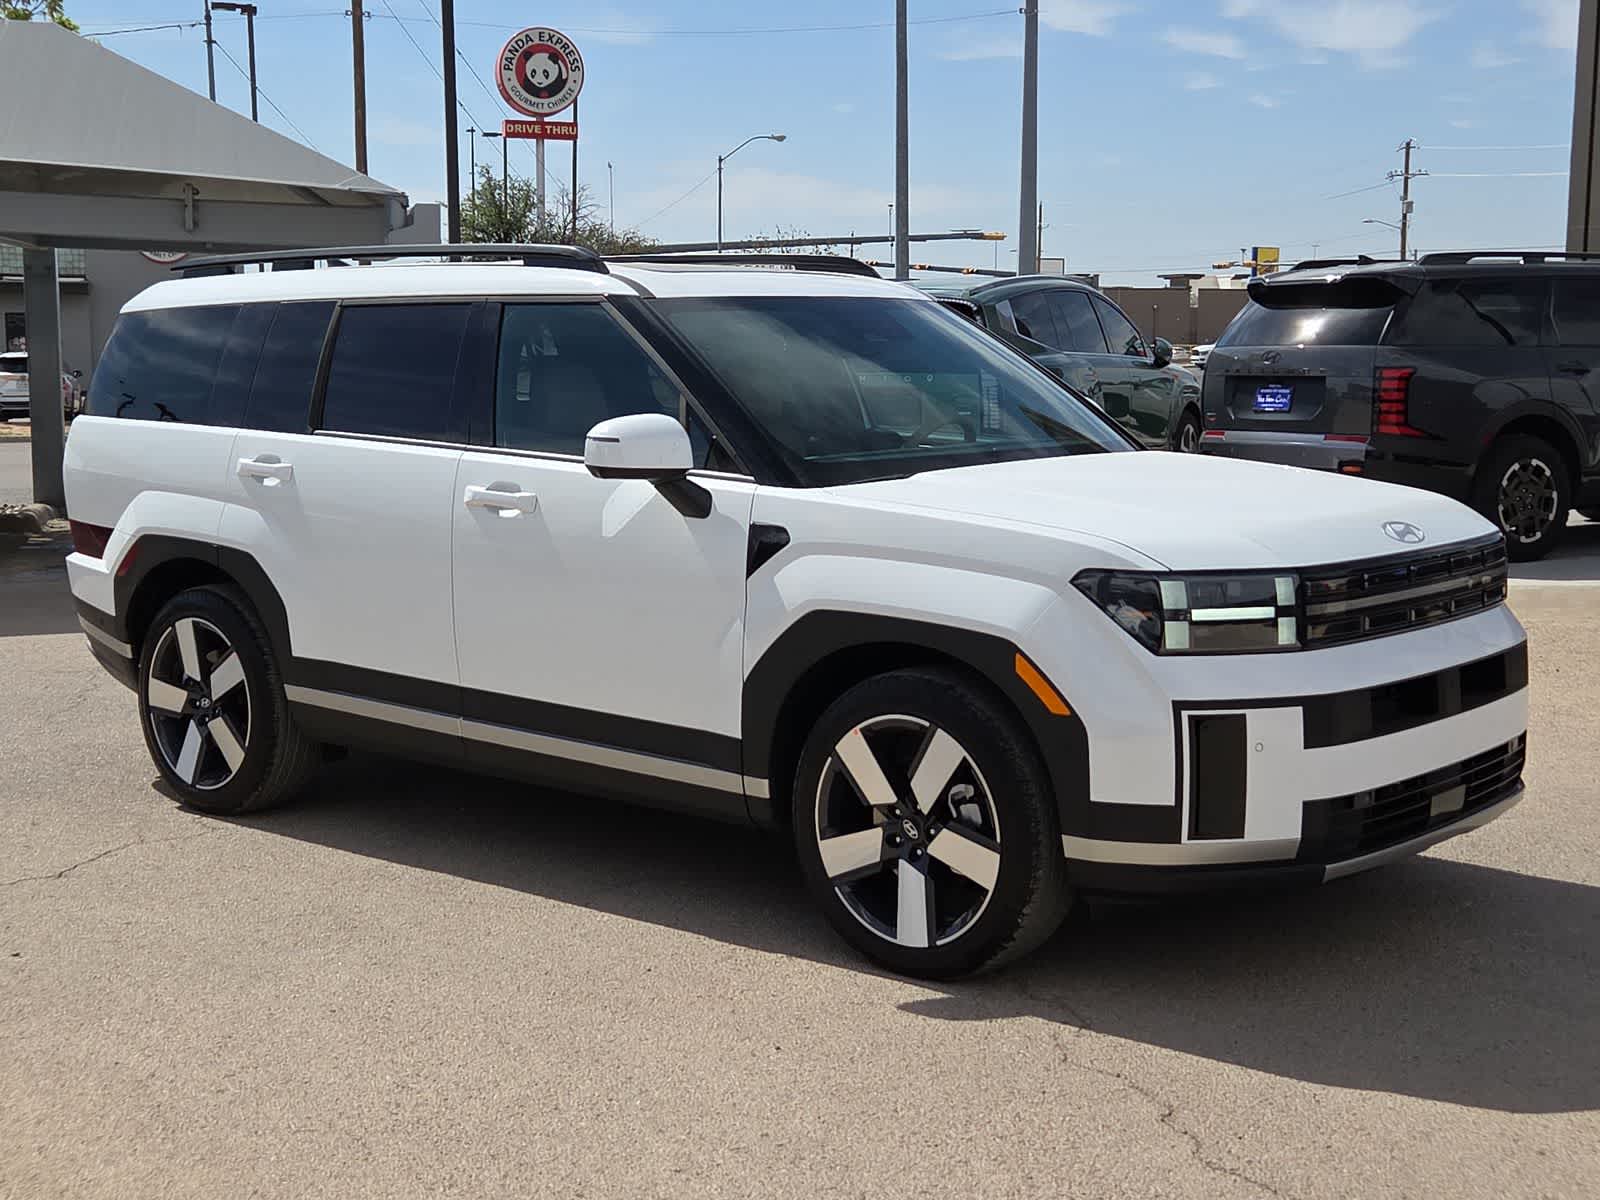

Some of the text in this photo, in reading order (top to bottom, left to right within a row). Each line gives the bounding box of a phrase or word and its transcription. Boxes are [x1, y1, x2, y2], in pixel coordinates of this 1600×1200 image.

[503, 31, 580, 73] PANDA EXPRESS
[510, 85, 575, 110] GOURMET CHINESE
[506, 123, 577, 135] DRIVE THRU
